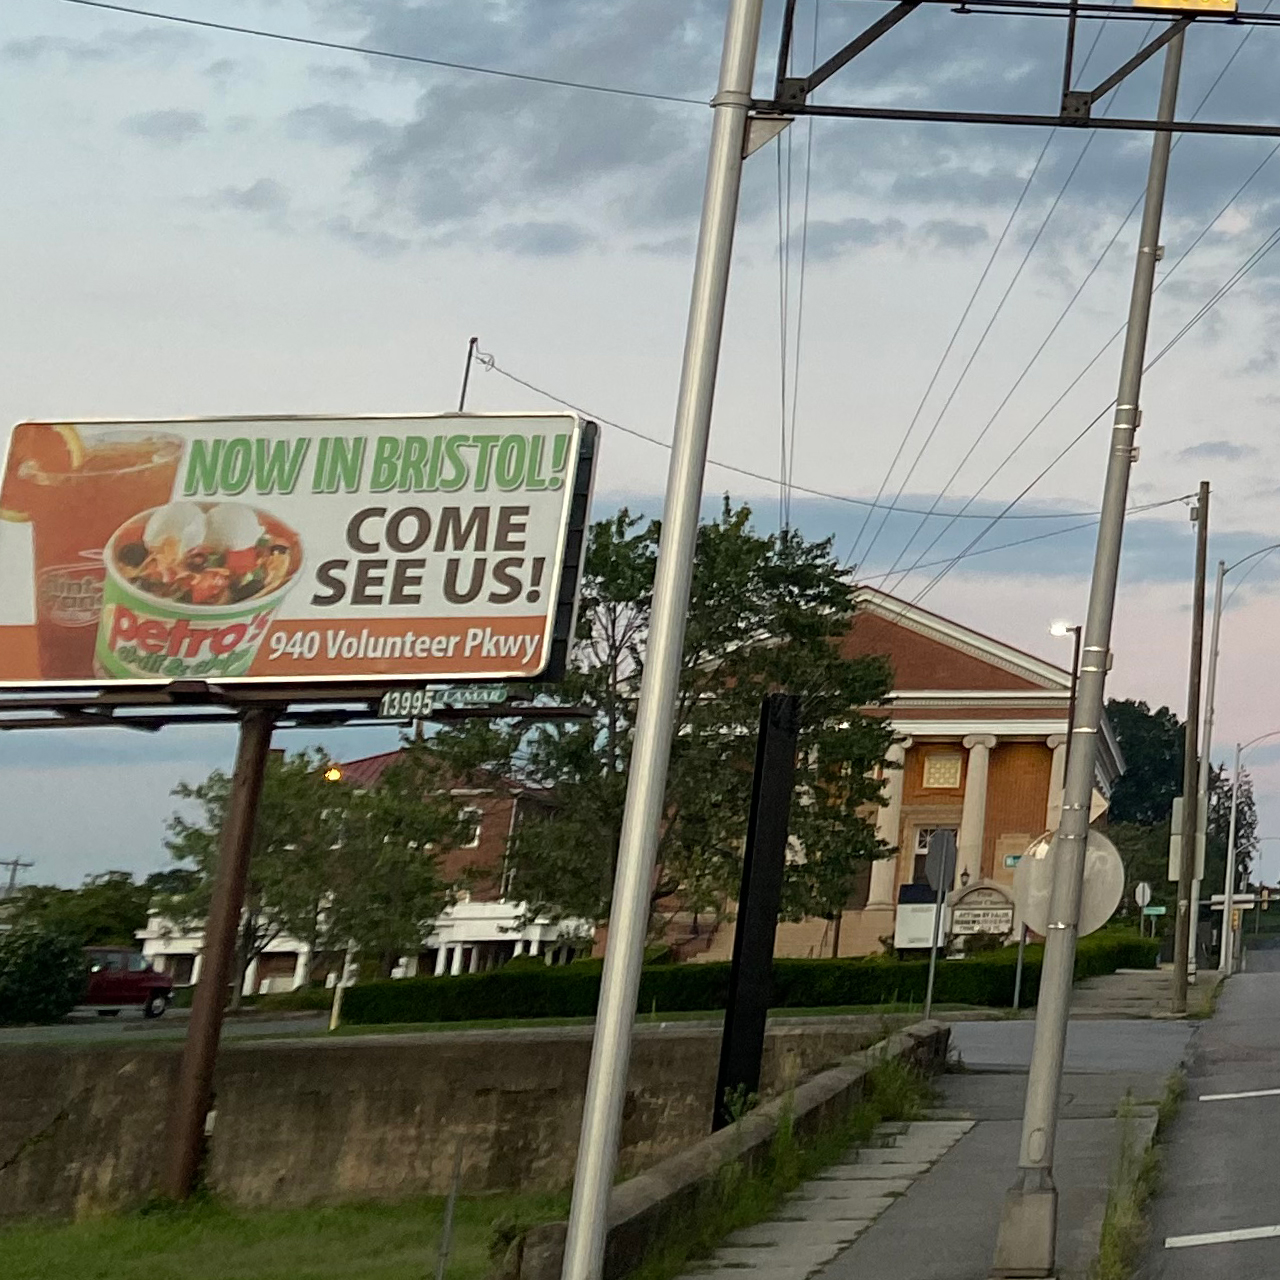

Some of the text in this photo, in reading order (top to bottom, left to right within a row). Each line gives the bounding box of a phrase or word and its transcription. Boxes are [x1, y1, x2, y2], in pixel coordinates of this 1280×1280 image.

[183, 433, 570, 496] NOW IN BRISTOL!
[346, 506, 531, 554] COME
[311, 556, 546, 606] SEE US!
[268, 627, 541, 663] 940 Volunteer Pkwy
[381, 691, 434, 716] 13995
[441, 689, 501, 701] LAMAR
